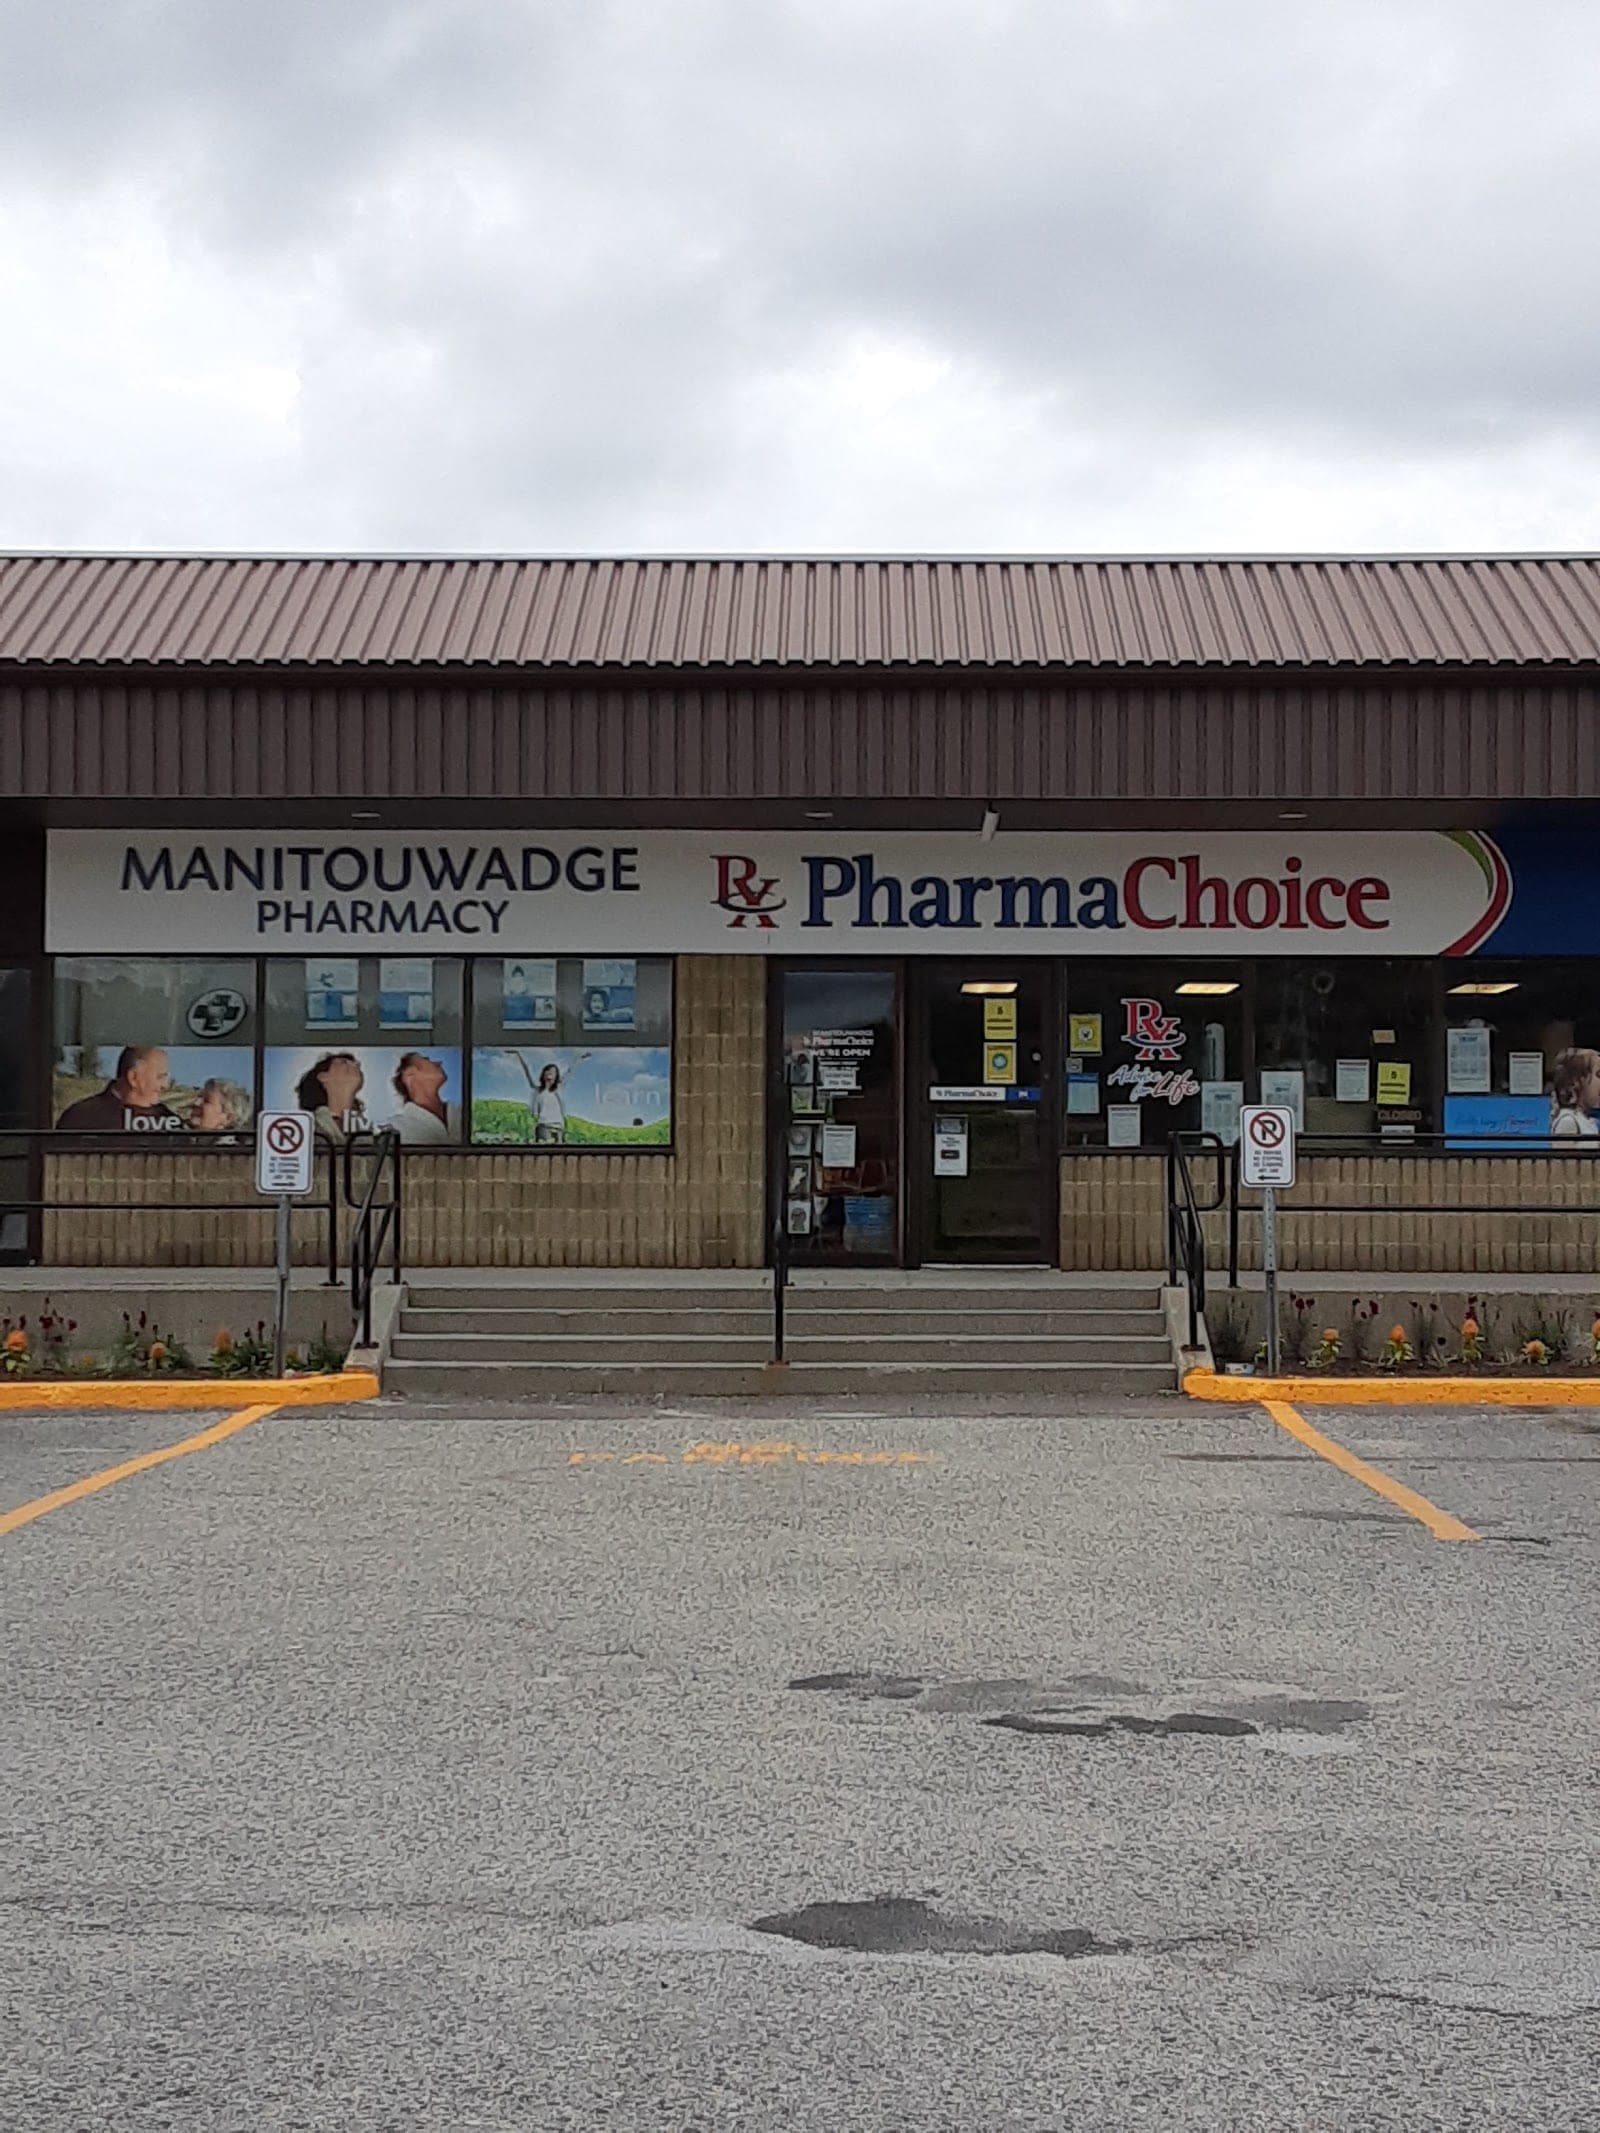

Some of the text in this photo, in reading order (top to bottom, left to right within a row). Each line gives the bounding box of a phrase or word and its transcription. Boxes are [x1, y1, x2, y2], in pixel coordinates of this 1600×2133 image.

[120, 846, 640, 892] MANITOUWADGE
[800, 854, 1391, 930] PharmaChoice
[256, 899, 510, 935] PHARMACY
[842, 1048, 871, 1056] OPEN
[594, 1081, 661, 1105] learn
[1151, 1069, 1201, 1106] Life
